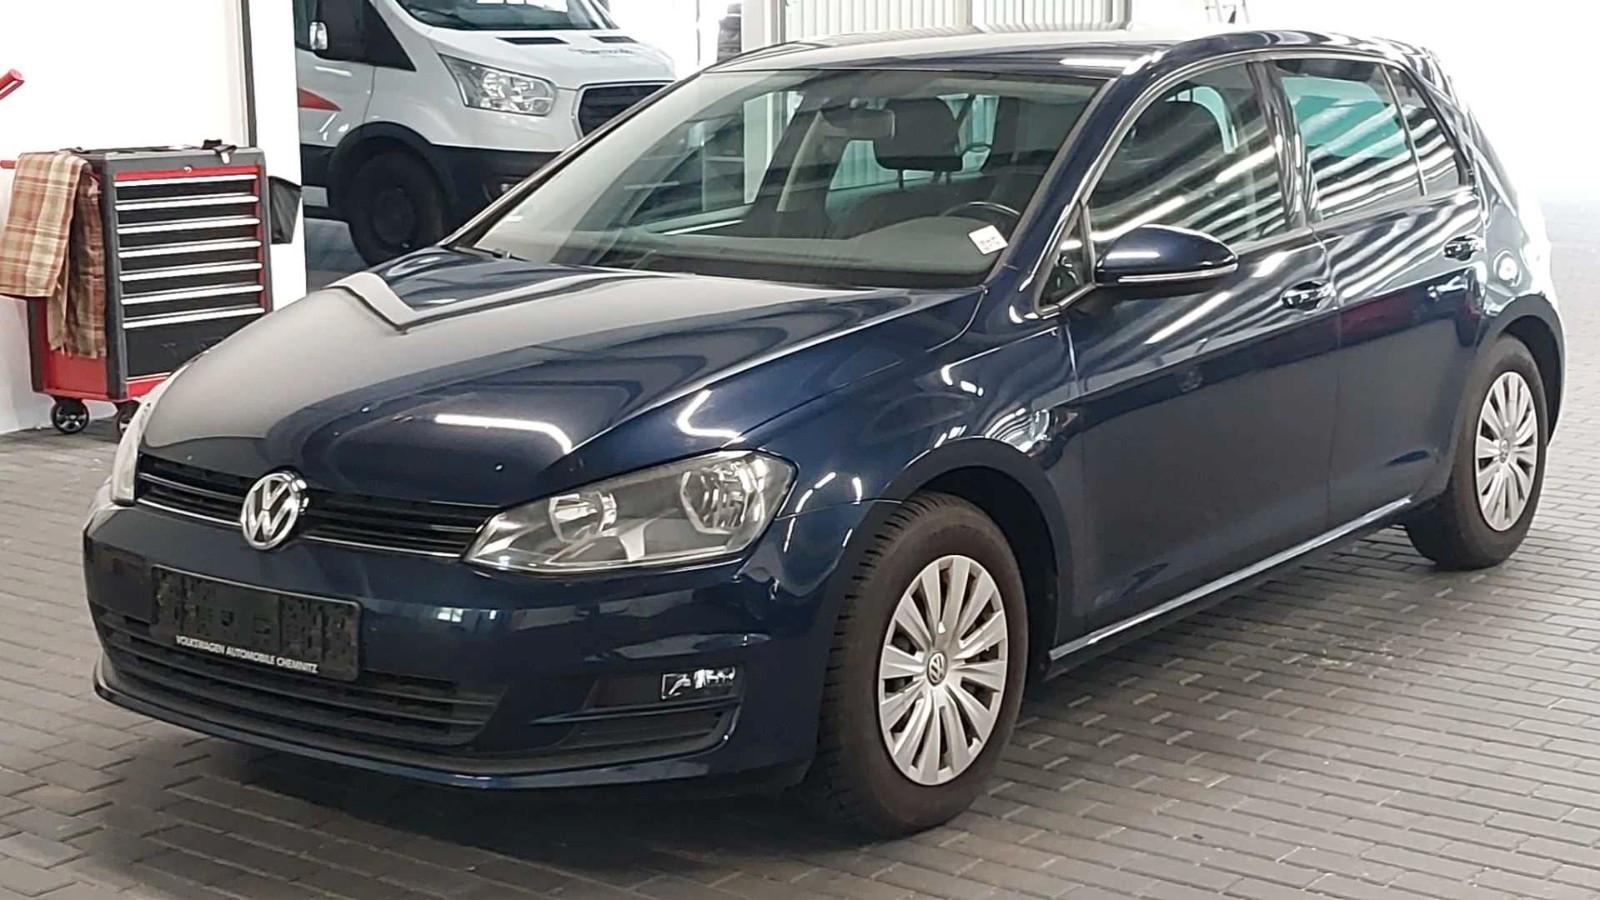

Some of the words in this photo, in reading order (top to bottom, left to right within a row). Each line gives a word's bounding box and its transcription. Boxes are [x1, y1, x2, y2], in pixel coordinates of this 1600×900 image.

[175, 635, 225, 655] VOLKSWAGEN
[226, 646, 276, 665] AUTOMOBILE
[276, 656, 319, 674] CHEMNITZ
